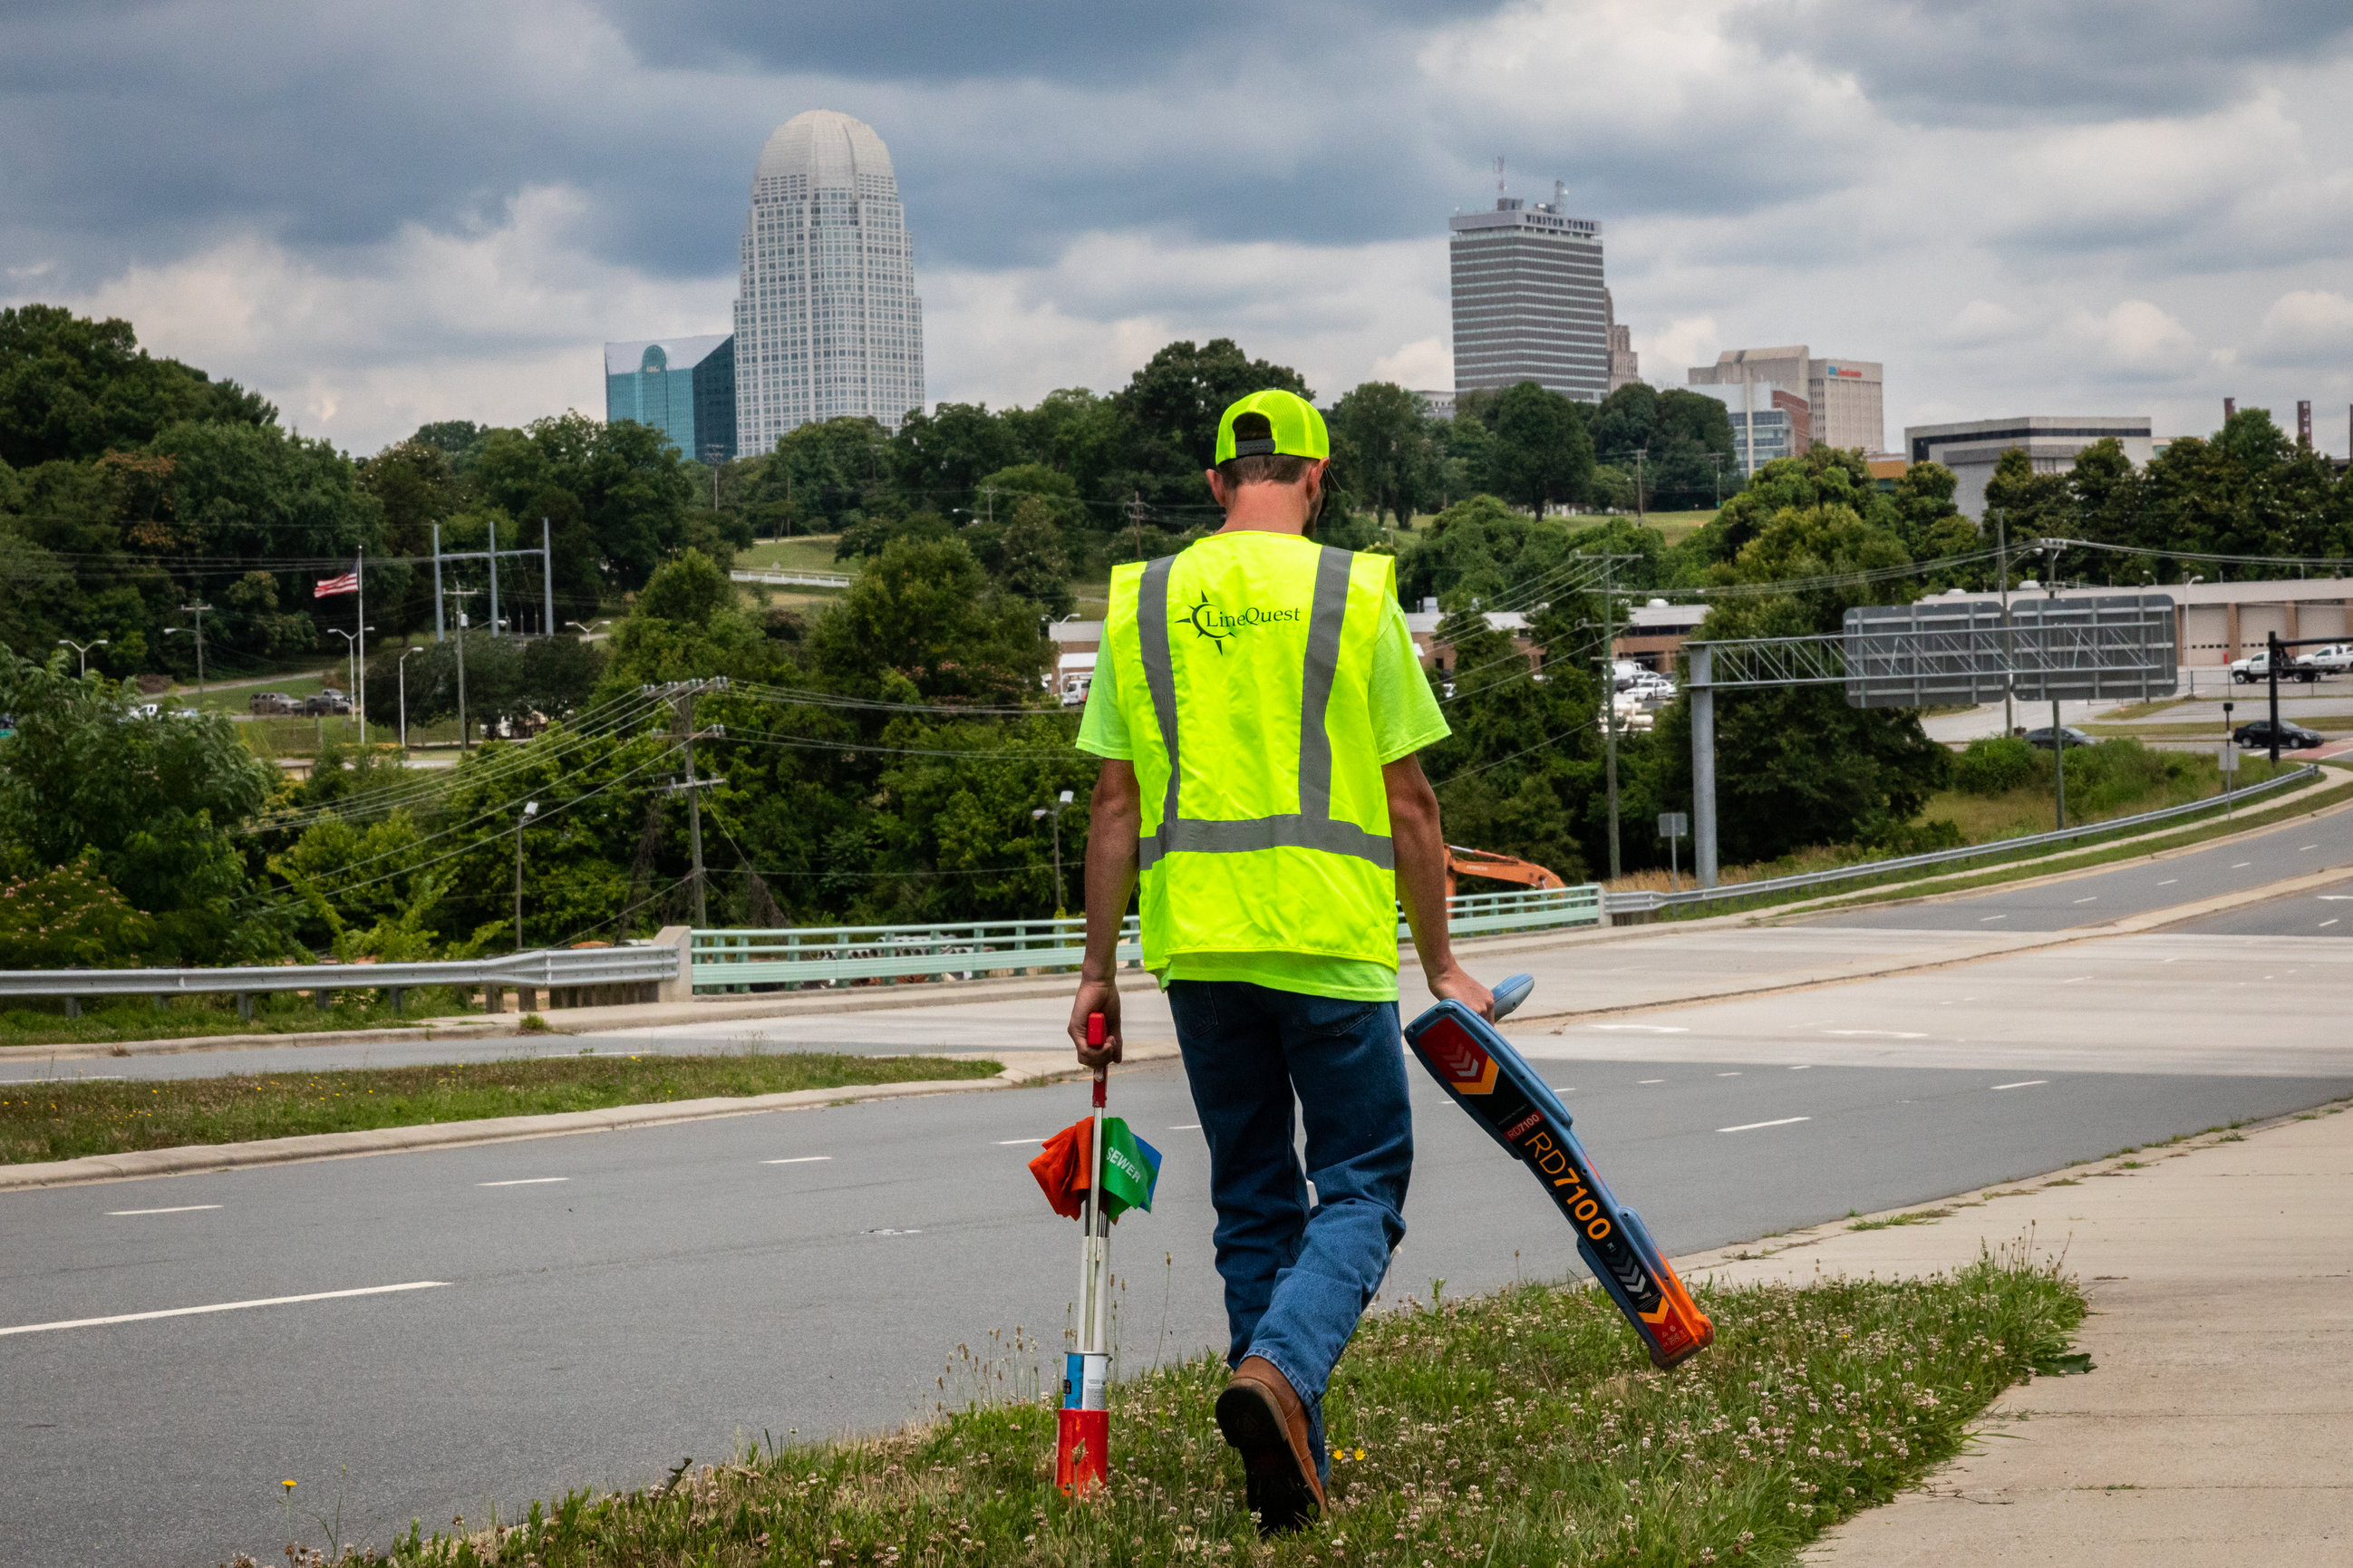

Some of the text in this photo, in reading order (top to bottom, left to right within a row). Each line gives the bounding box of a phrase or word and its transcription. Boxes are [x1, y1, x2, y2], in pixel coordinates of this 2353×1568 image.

[1525, 215, 1595, 231] WINSTON TOWER
[1206, 607, 1301, 627] LineQuest
[1507, 1114, 1540, 1138] RD7100
[1106, 1147, 1141, 1183] SEWER
[1525, 1131, 1612, 1240] RD7100
